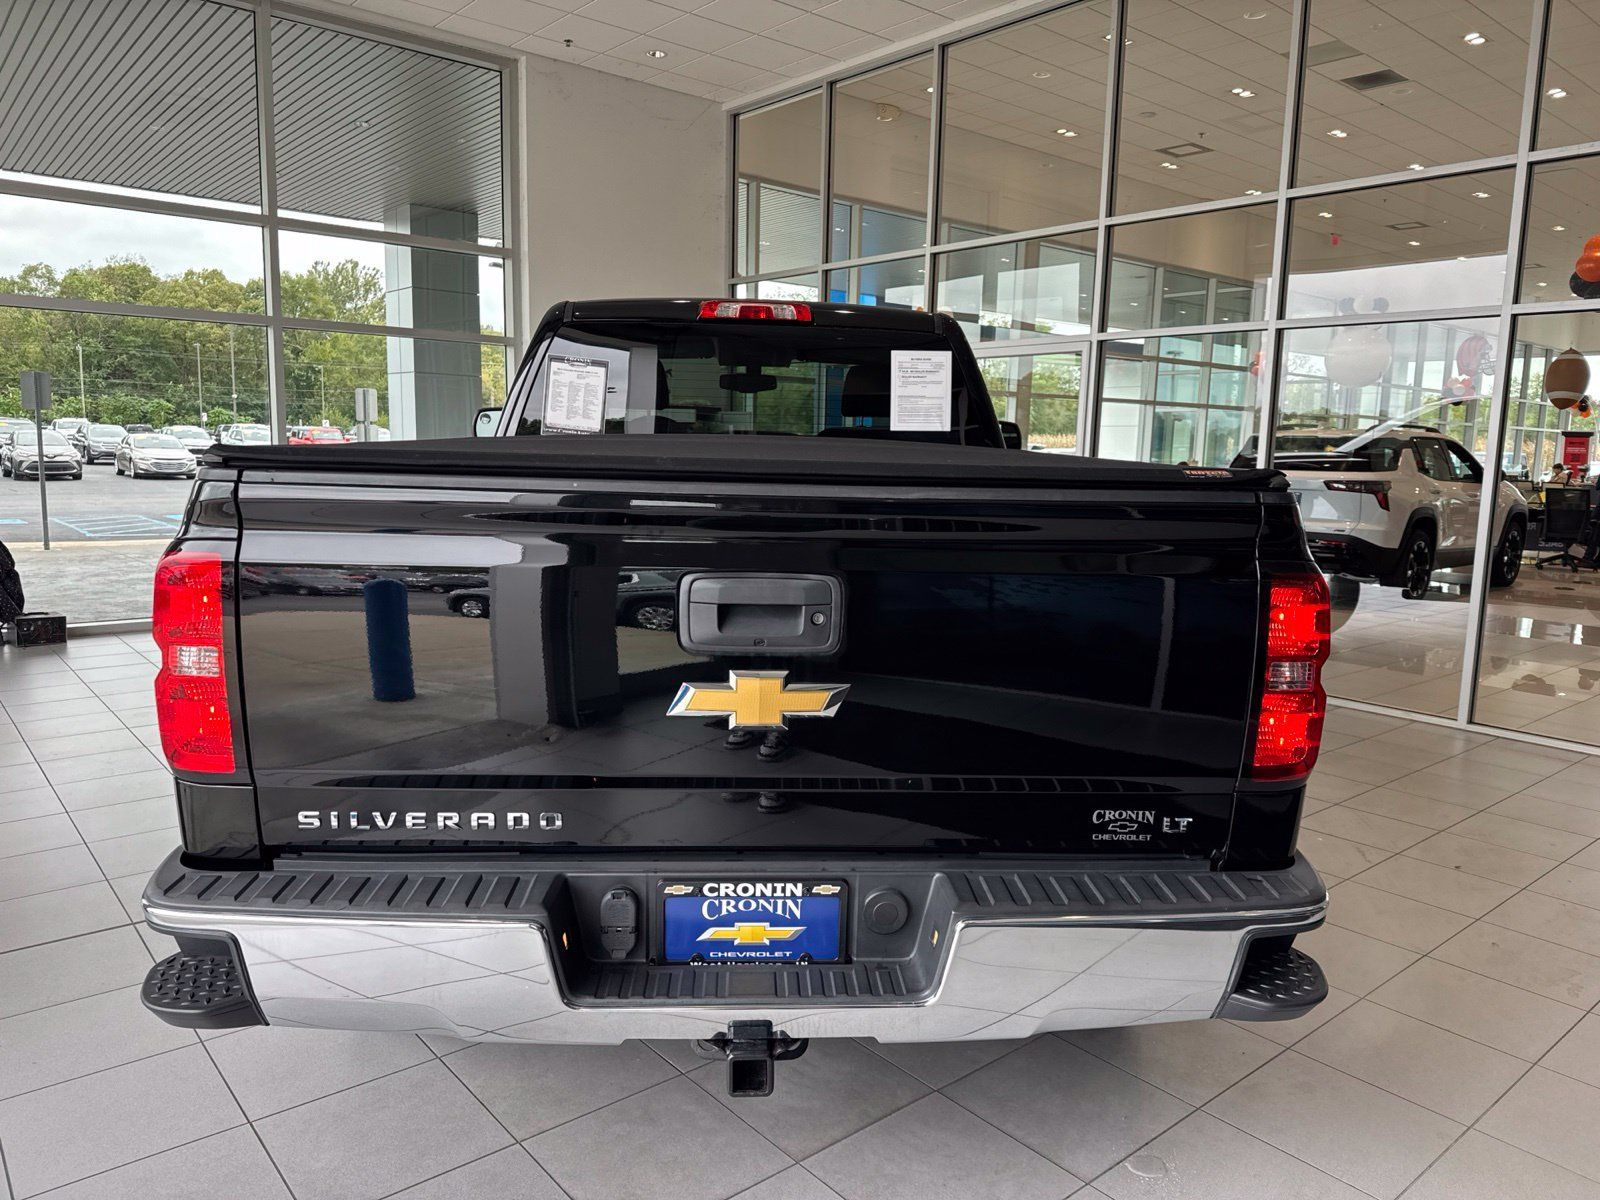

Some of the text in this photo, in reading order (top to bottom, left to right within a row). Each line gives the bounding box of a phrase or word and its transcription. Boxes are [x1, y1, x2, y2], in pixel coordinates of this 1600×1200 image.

[297, 811, 563, 831] SILVERADO
[1092, 809, 1156, 825] CRONIN
[1162, 816, 1194, 833] LT
[1092, 833, 1153, 841] CHEVROLET
[702, 882, 803, 897] CRONIN
[701, 898, 803, 920] CRONIN
